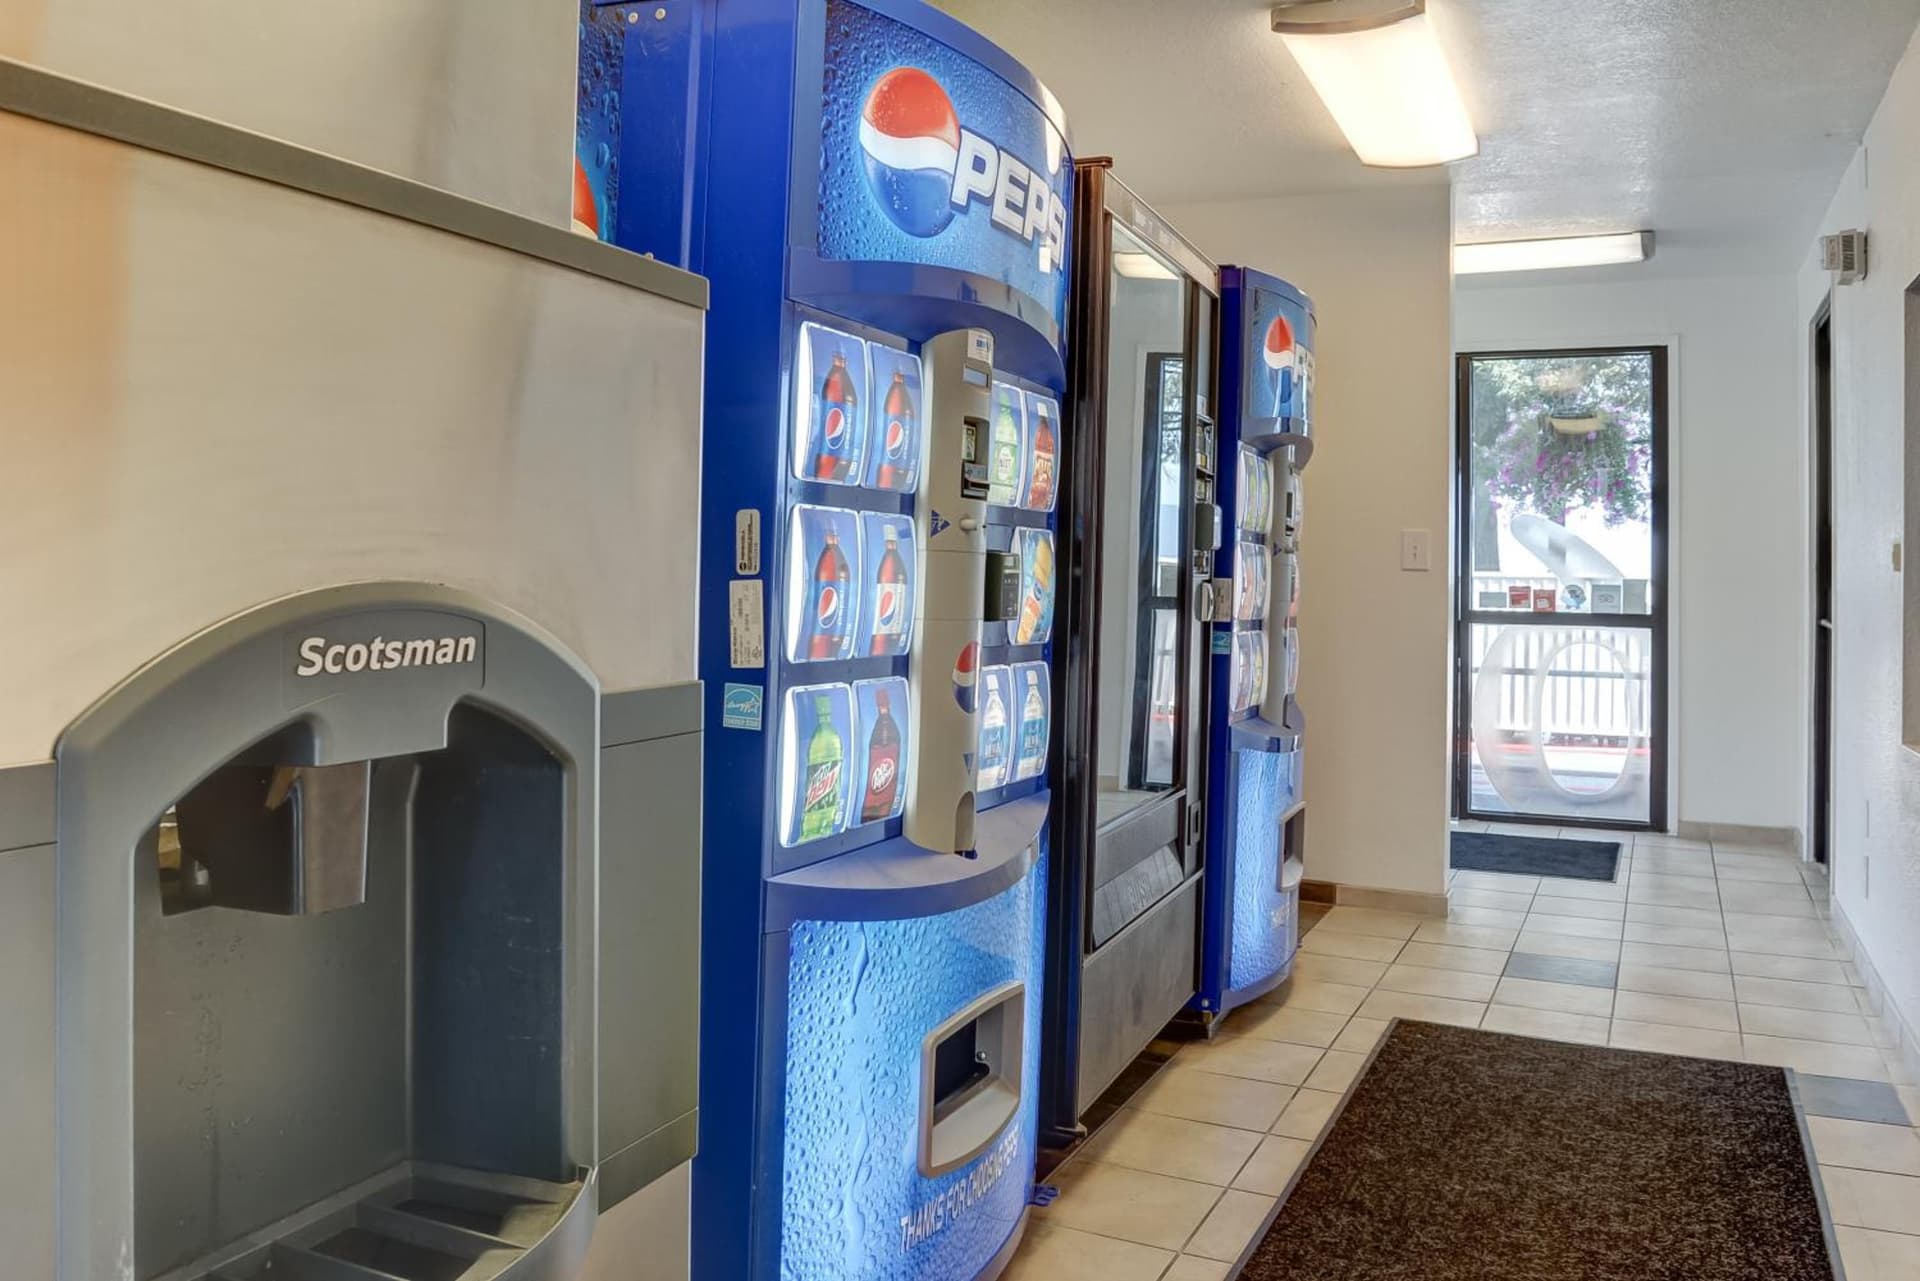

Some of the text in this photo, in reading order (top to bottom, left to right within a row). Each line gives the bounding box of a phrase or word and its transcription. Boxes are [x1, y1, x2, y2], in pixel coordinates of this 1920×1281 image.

[297, 635, 476, 677] Scotsman
[900, 1193, 946, 1255] THANKS
[947, 1178, 967, 1221] FOR
